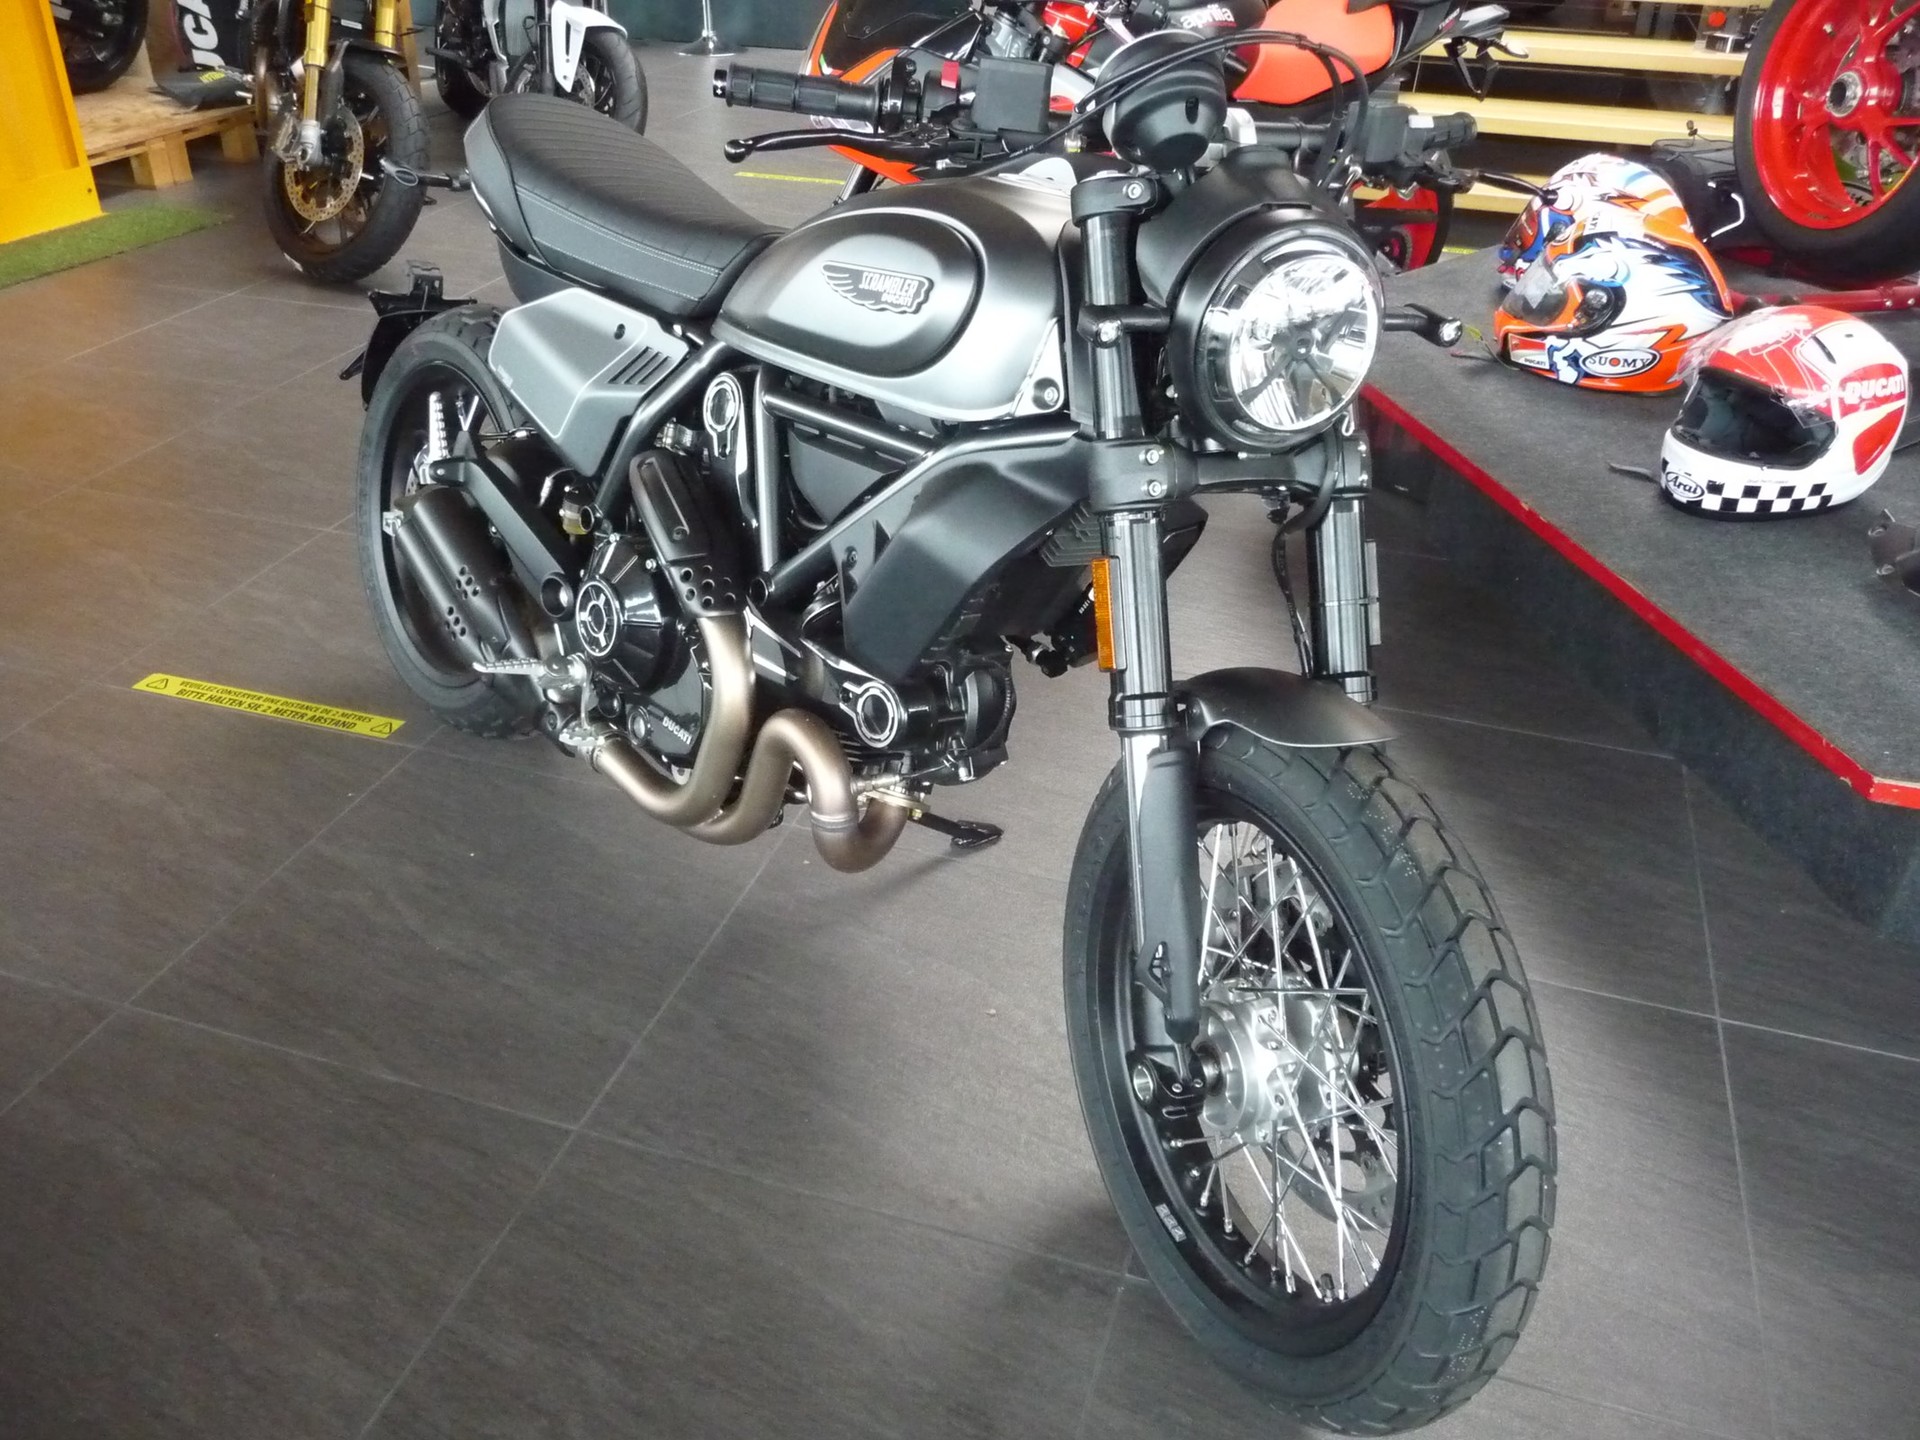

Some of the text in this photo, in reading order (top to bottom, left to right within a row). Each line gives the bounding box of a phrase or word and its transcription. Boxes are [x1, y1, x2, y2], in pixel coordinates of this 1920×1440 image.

[1180, 4, 1235, 29] aprilia
[858, 271, 919, 297] SCRAMBLER
[1523, 357, 1547, 366] DUCATI
[1589, 355, 1651, 368] SUOMY
[1844, 374, 1905, 405] DUCATI
[1666, 475, 1698, 495] Arai
[176, 689, 357, 730] BITTE HALTEN SIE 2 METER ABSTAND
[180, 681, 217, 692] VEUILLEZ
[216, 688, 263, 701] CONSERVER
[262, 696, 282, 705] UNE
[281, 700, 321, 713] DISTANCE
[662, 716, 692, 745] DUCATI
